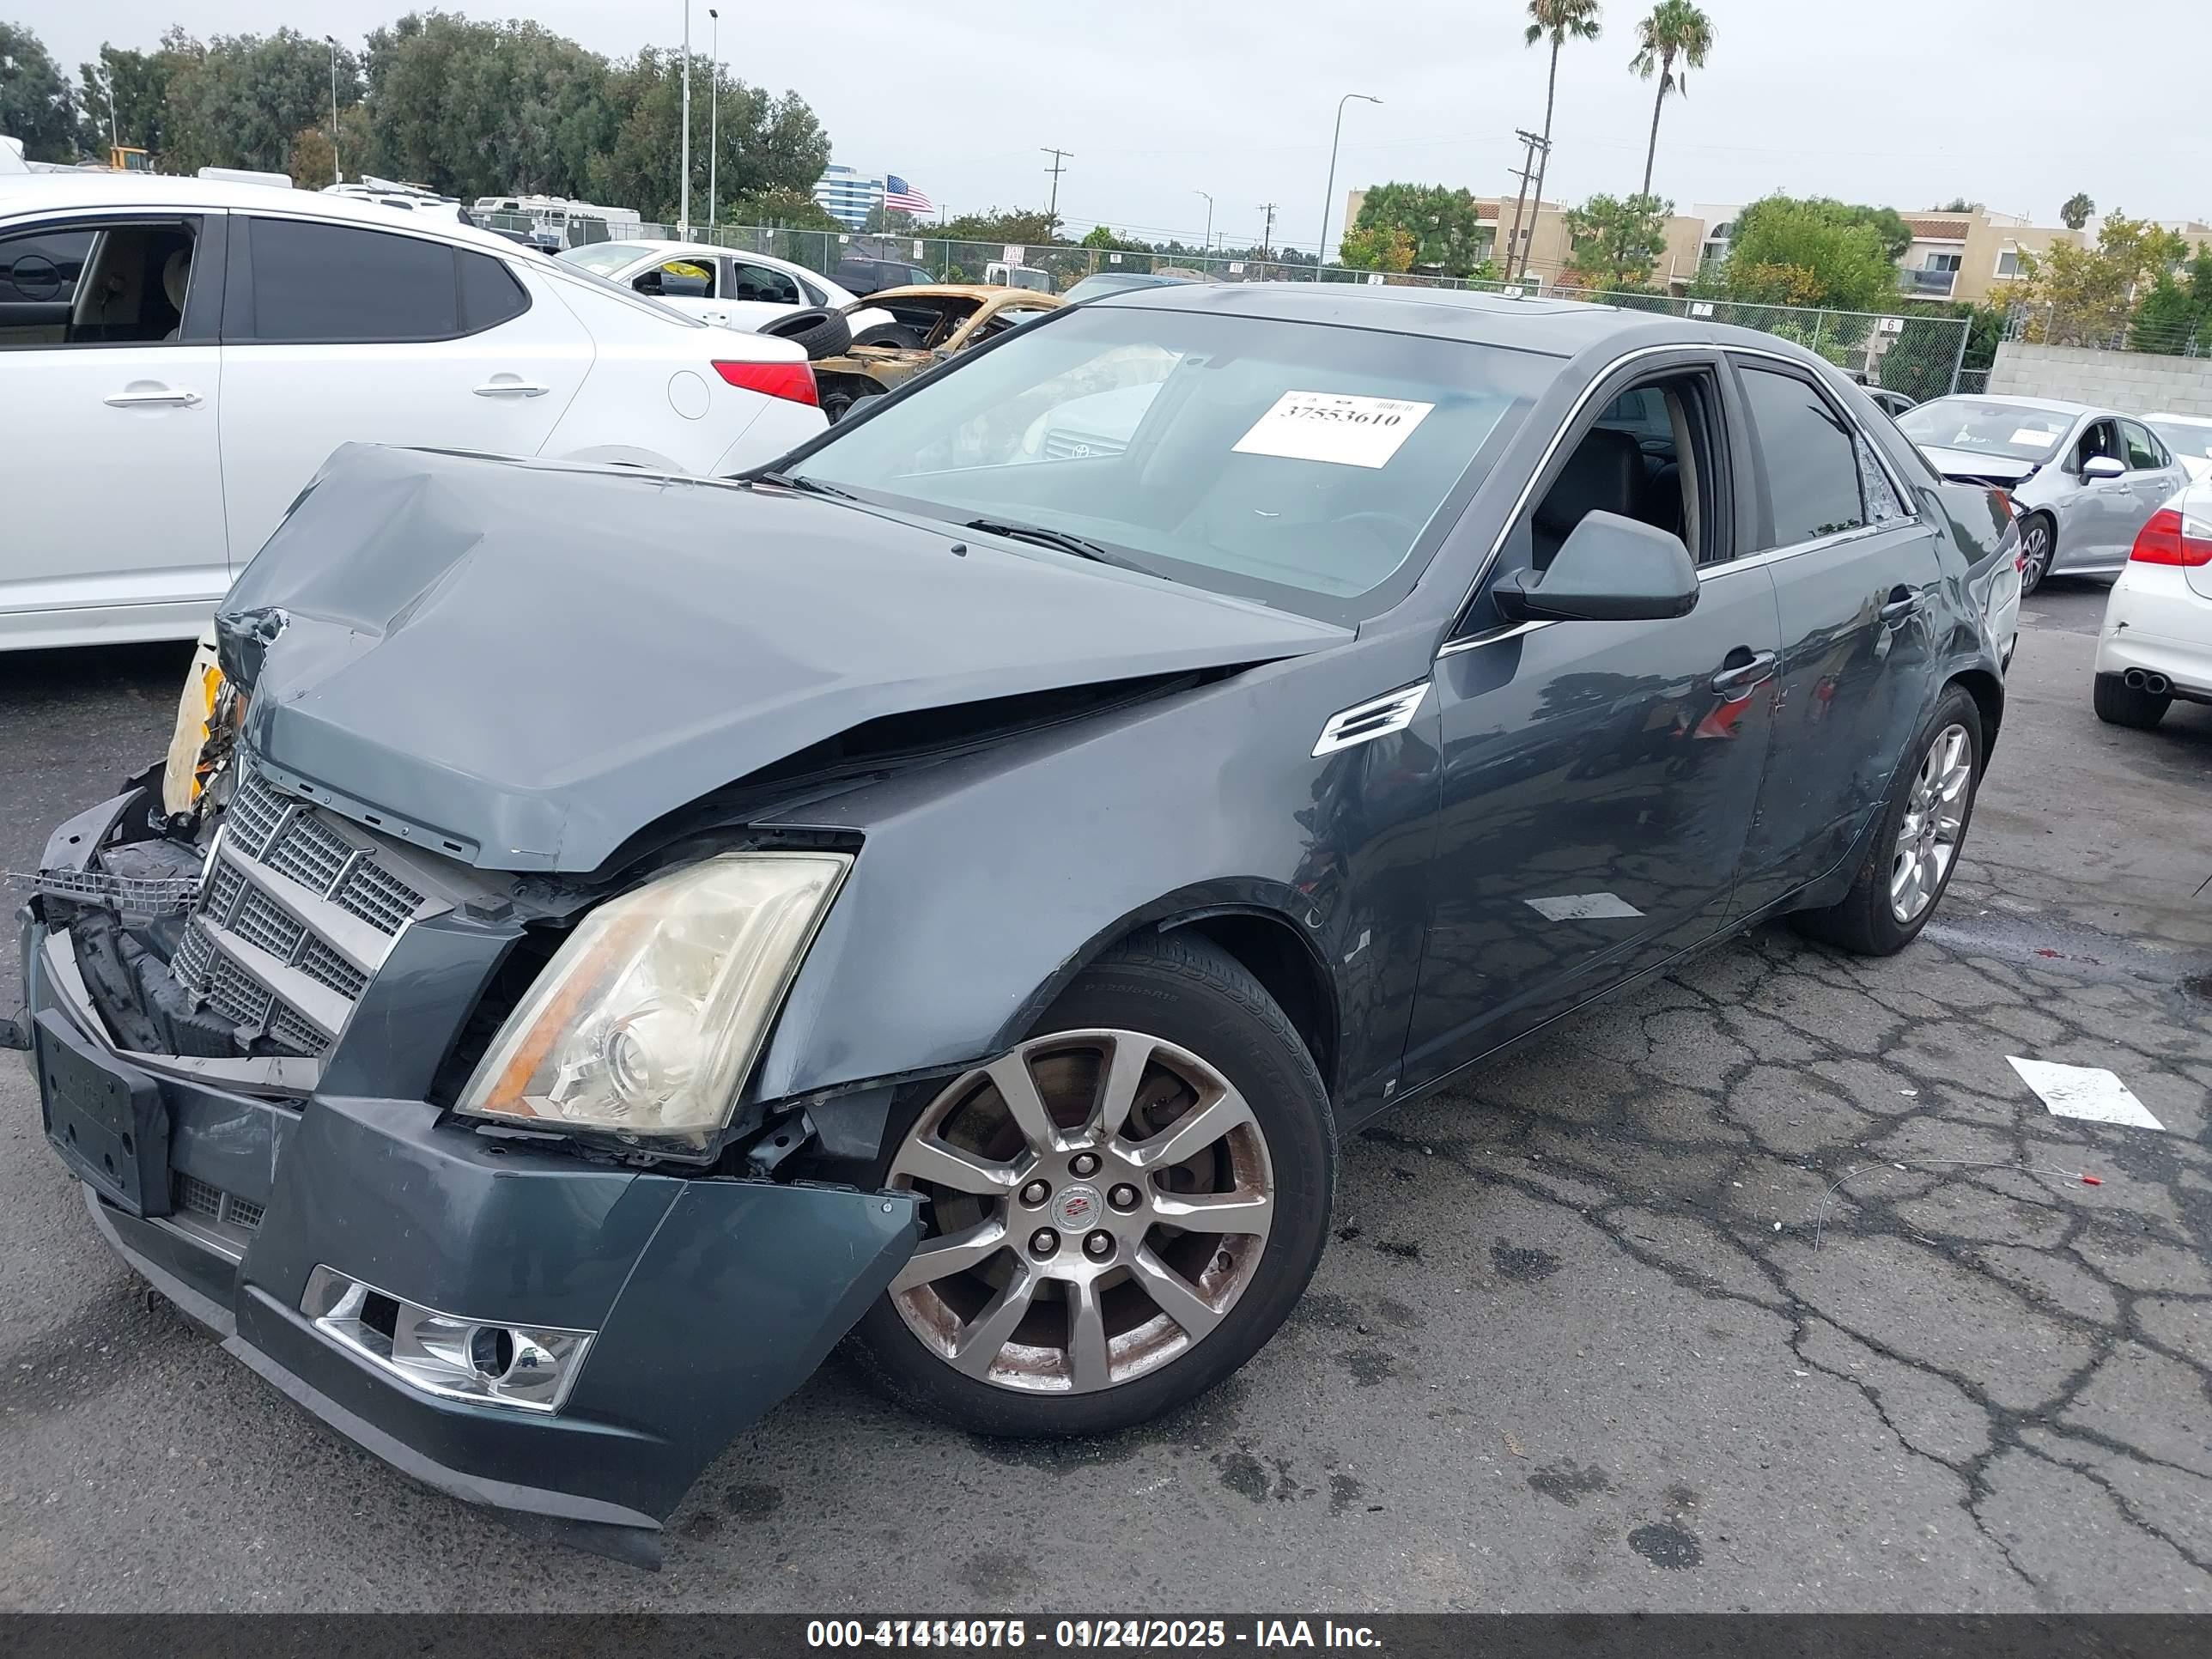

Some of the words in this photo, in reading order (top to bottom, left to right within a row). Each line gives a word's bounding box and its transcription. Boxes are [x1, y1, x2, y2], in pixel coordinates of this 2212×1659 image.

[1233, 264, 1242, 272] 10
[1374, 276, 1379, 284] 9
[1700, 304, 1706, 314] 7
[1887, 319, 1895, 331] 6
[1280, 406, 1401, 426] 37553610
